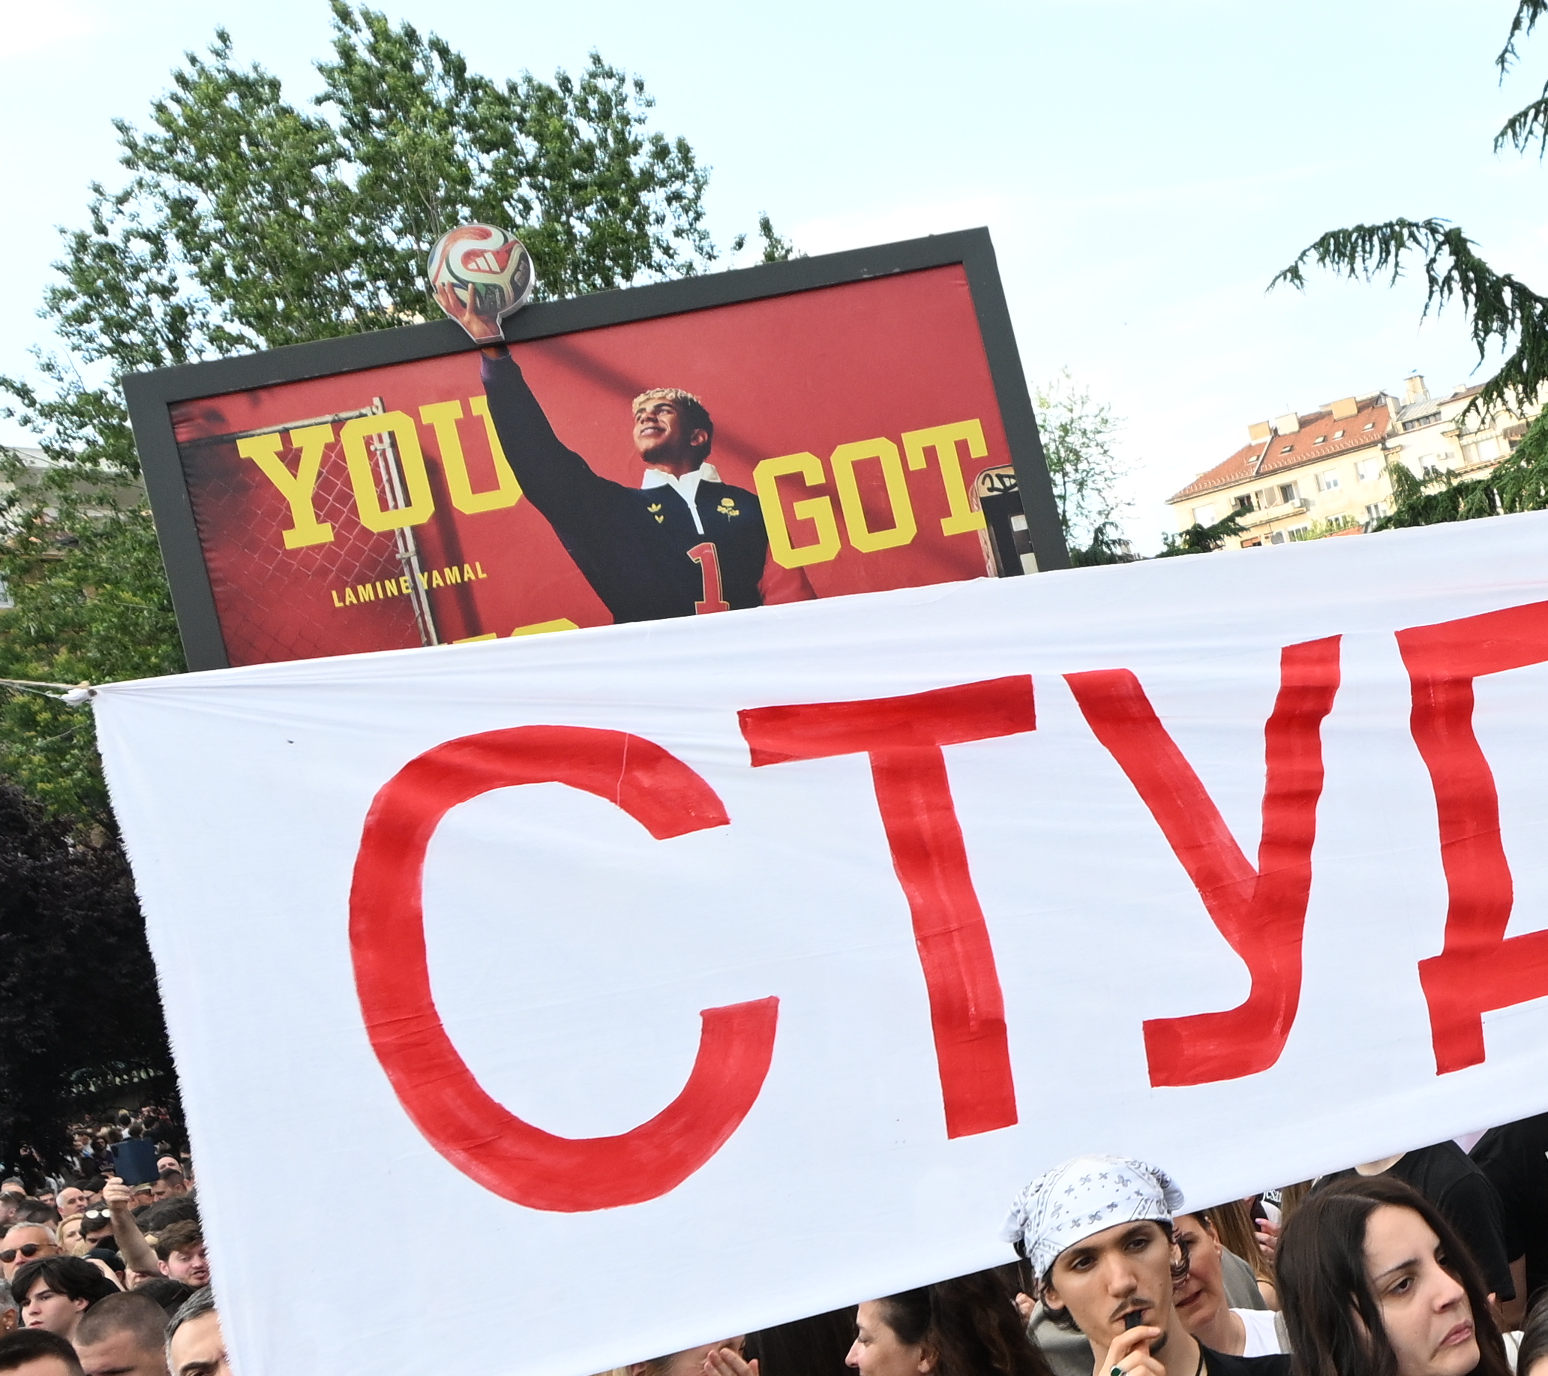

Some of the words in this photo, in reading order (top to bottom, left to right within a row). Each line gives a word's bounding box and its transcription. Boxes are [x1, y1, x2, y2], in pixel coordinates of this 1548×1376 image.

[236, 395, 524, 550] YOU
[753, 417, 989, 569] GOT
[331, 573, 414, 609] LAMINE
[415, 561, 489, 594] YAMAL
